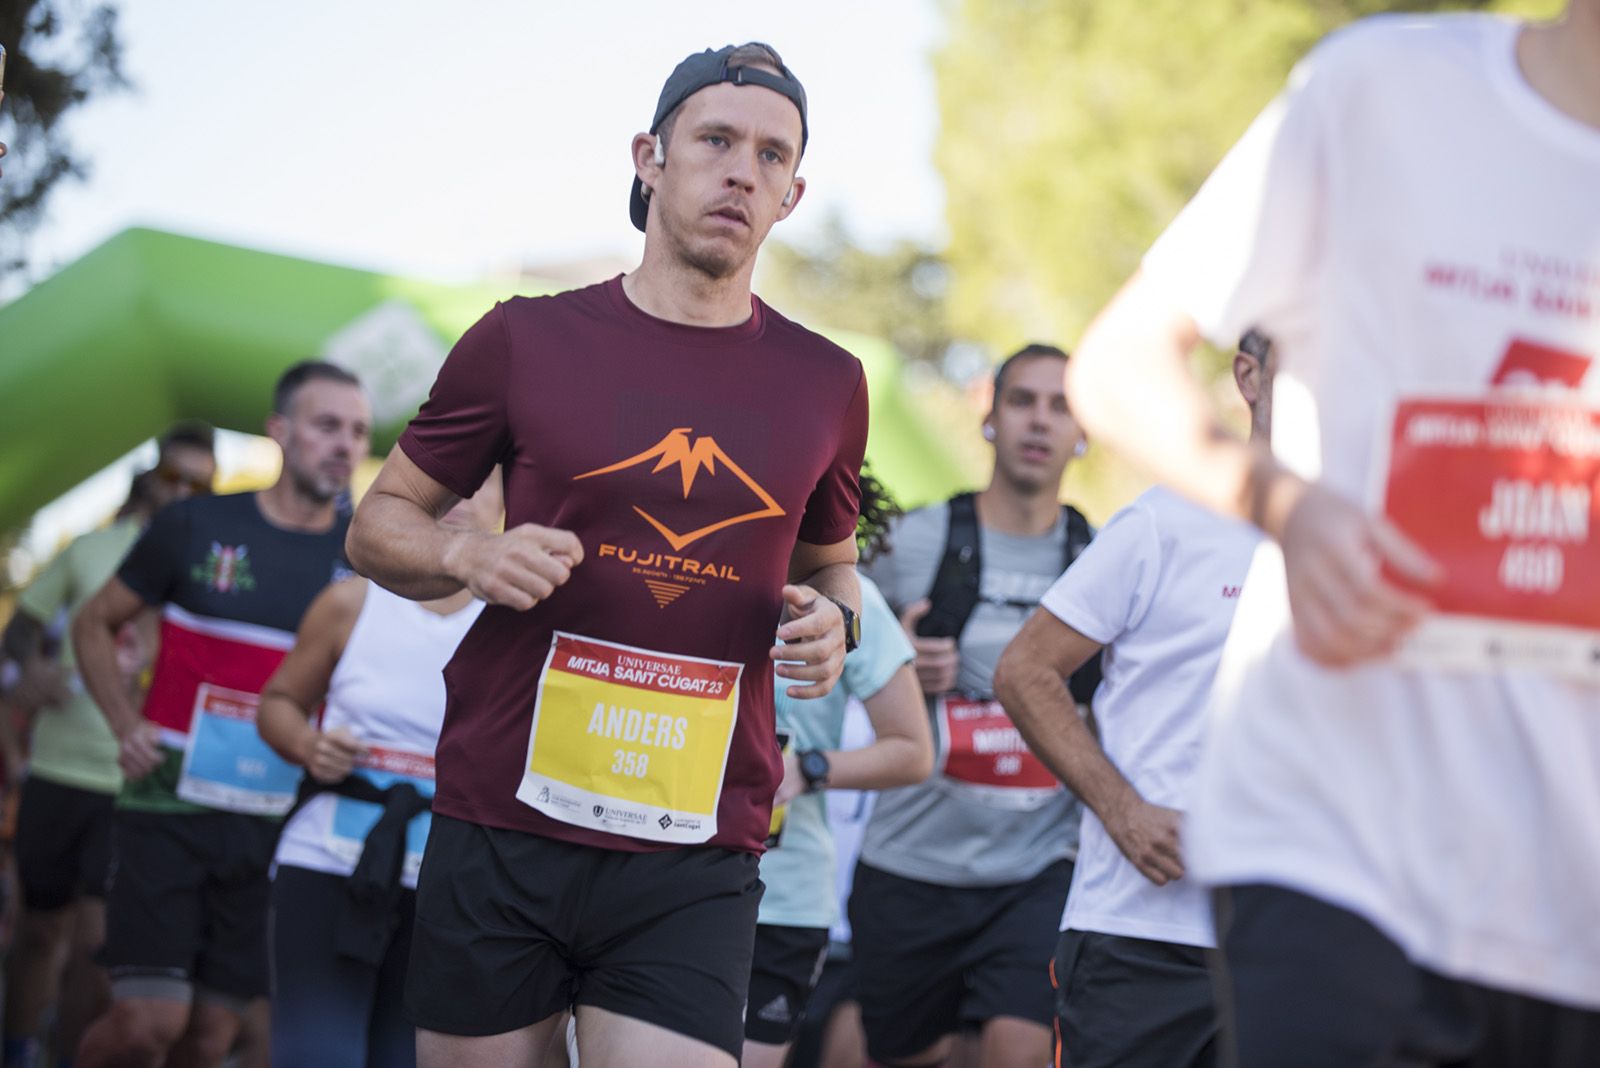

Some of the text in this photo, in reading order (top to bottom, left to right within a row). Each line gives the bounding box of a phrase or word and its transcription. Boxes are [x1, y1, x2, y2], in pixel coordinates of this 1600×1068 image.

[1477, 477, 1590, 545] JOAN
[598, 543, 741, 582] FUJITRAIL
[567, 655, 610, 677] MITJA
[614, 665, 657, 685] SANT
[617, 655, 682, 675] UNIVERSAE
[587, 702, 689, 750] ANDERS
[611, 748, 649, 778] 358
